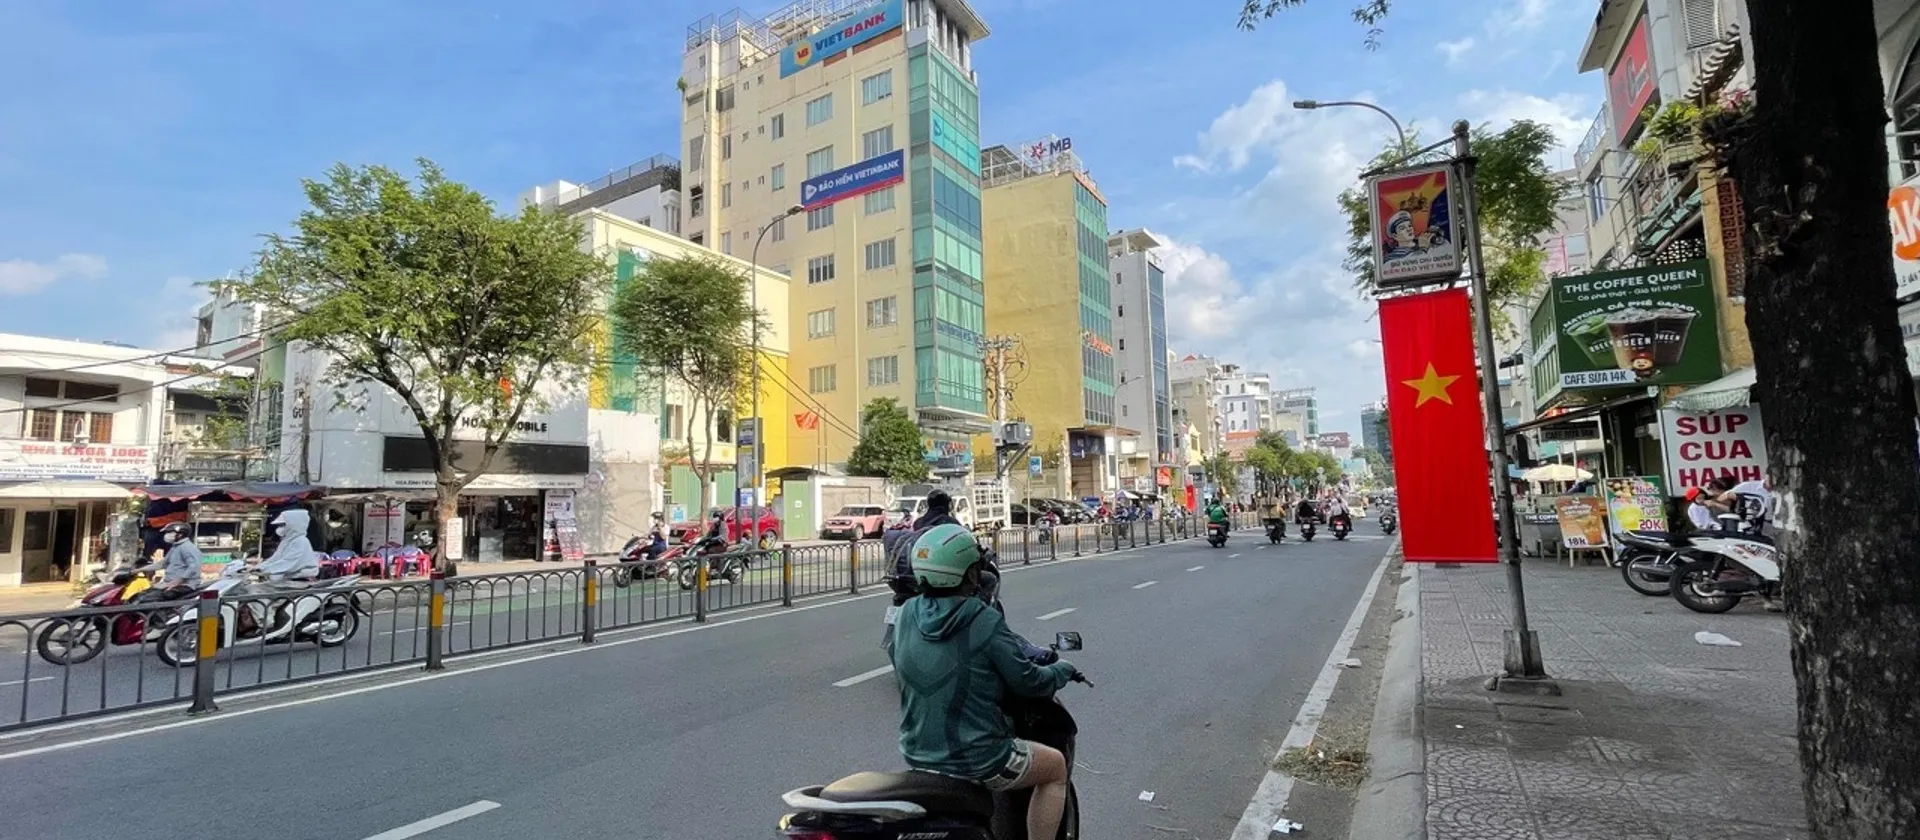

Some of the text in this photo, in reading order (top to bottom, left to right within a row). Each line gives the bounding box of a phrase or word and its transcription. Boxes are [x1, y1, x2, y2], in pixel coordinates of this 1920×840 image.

[815, 12, 886, 51] VIETBANK
[1050, 137, 1071, 154] MB
[854, 159, 900, 181] VIETINBANK
[1564, 269, 1698, 294] THE COFFEE QUEEN
[1563, 307, 1604, 328] MATCHA
[1656, 300, 1695, 313] CACAO
[1616, 337, 1652, 348] QUEEN
[1565, 373, 1587, 386] CAFE
[1610, 370, 1627, 382] 14K
[1675, 412, 1749, 436] SÚP
[62, 446, 106, 457] KHOA
[1679, 440, 1753, 462] CUA
[1639, 519, 1662, 530] 20K
